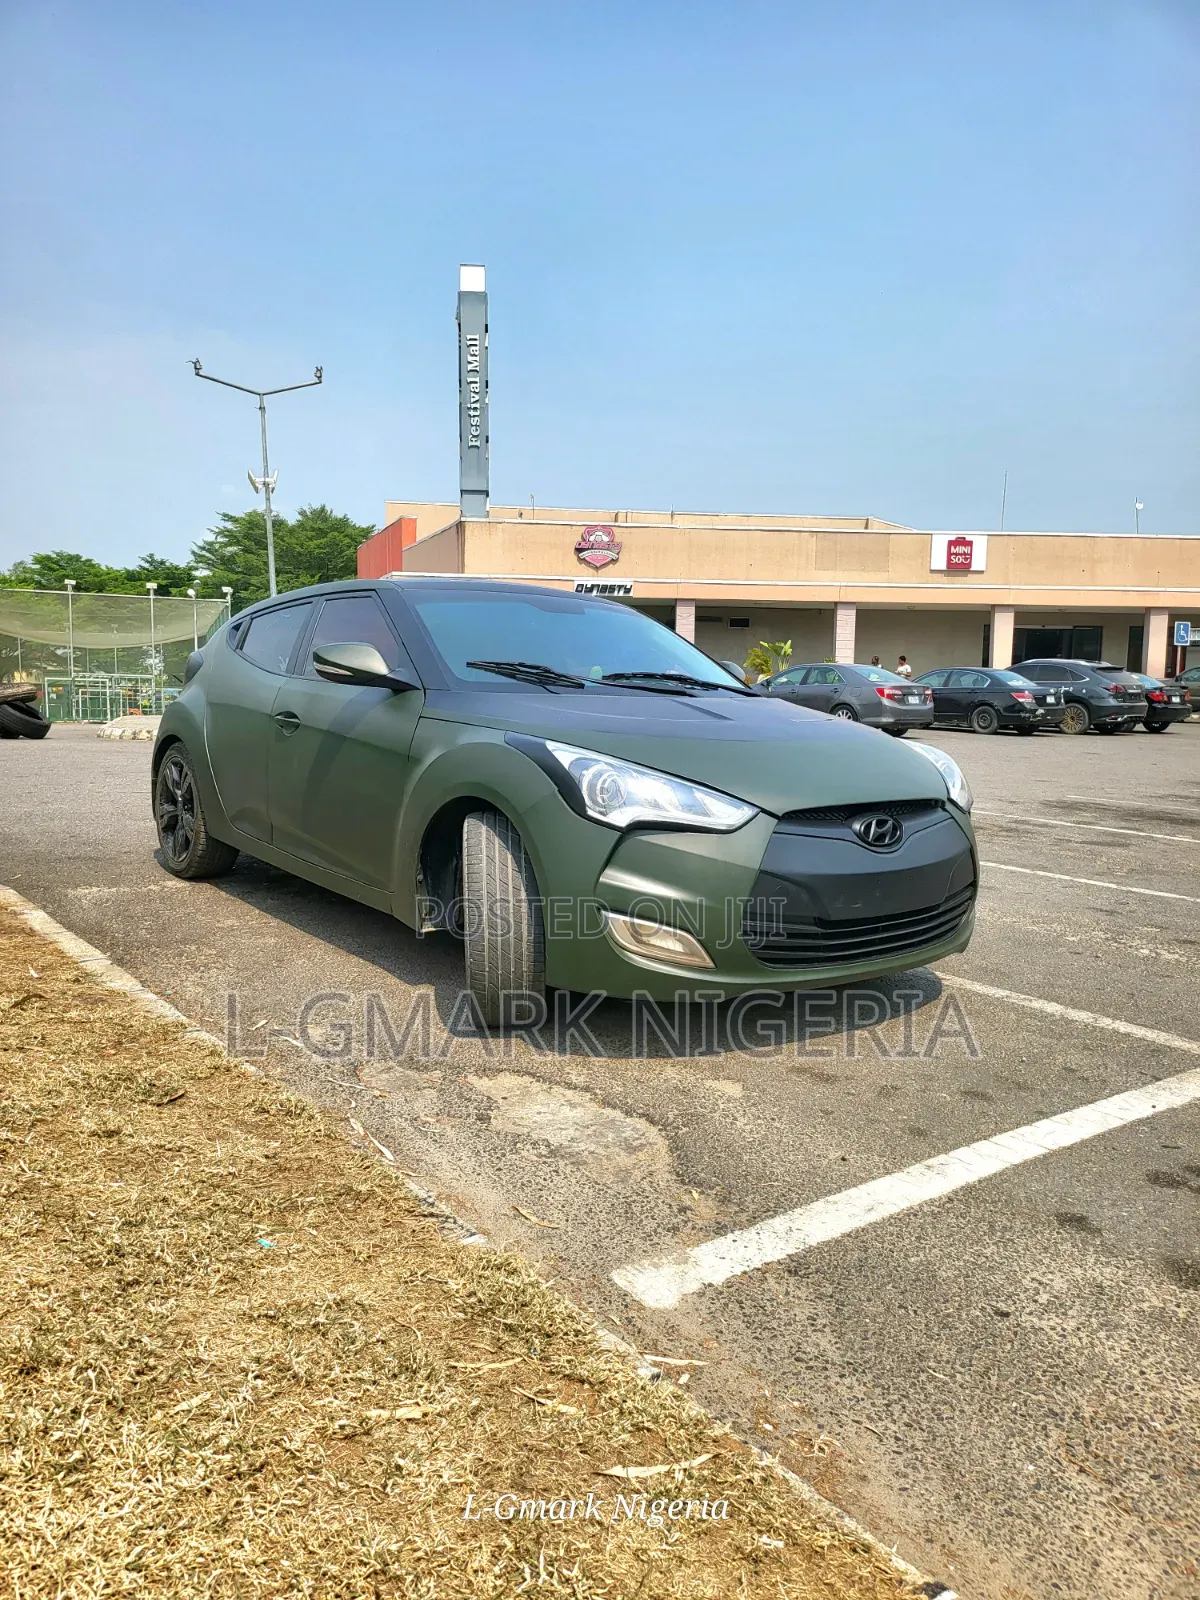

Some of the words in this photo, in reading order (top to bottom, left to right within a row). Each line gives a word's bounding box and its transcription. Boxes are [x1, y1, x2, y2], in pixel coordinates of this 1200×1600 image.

[466, 334, 480, 372] Mall
[467, 377, 480, 449] Festival
[950, 545, 971, 554] MINI
[575, 583, 633, 594] DYNASTY
